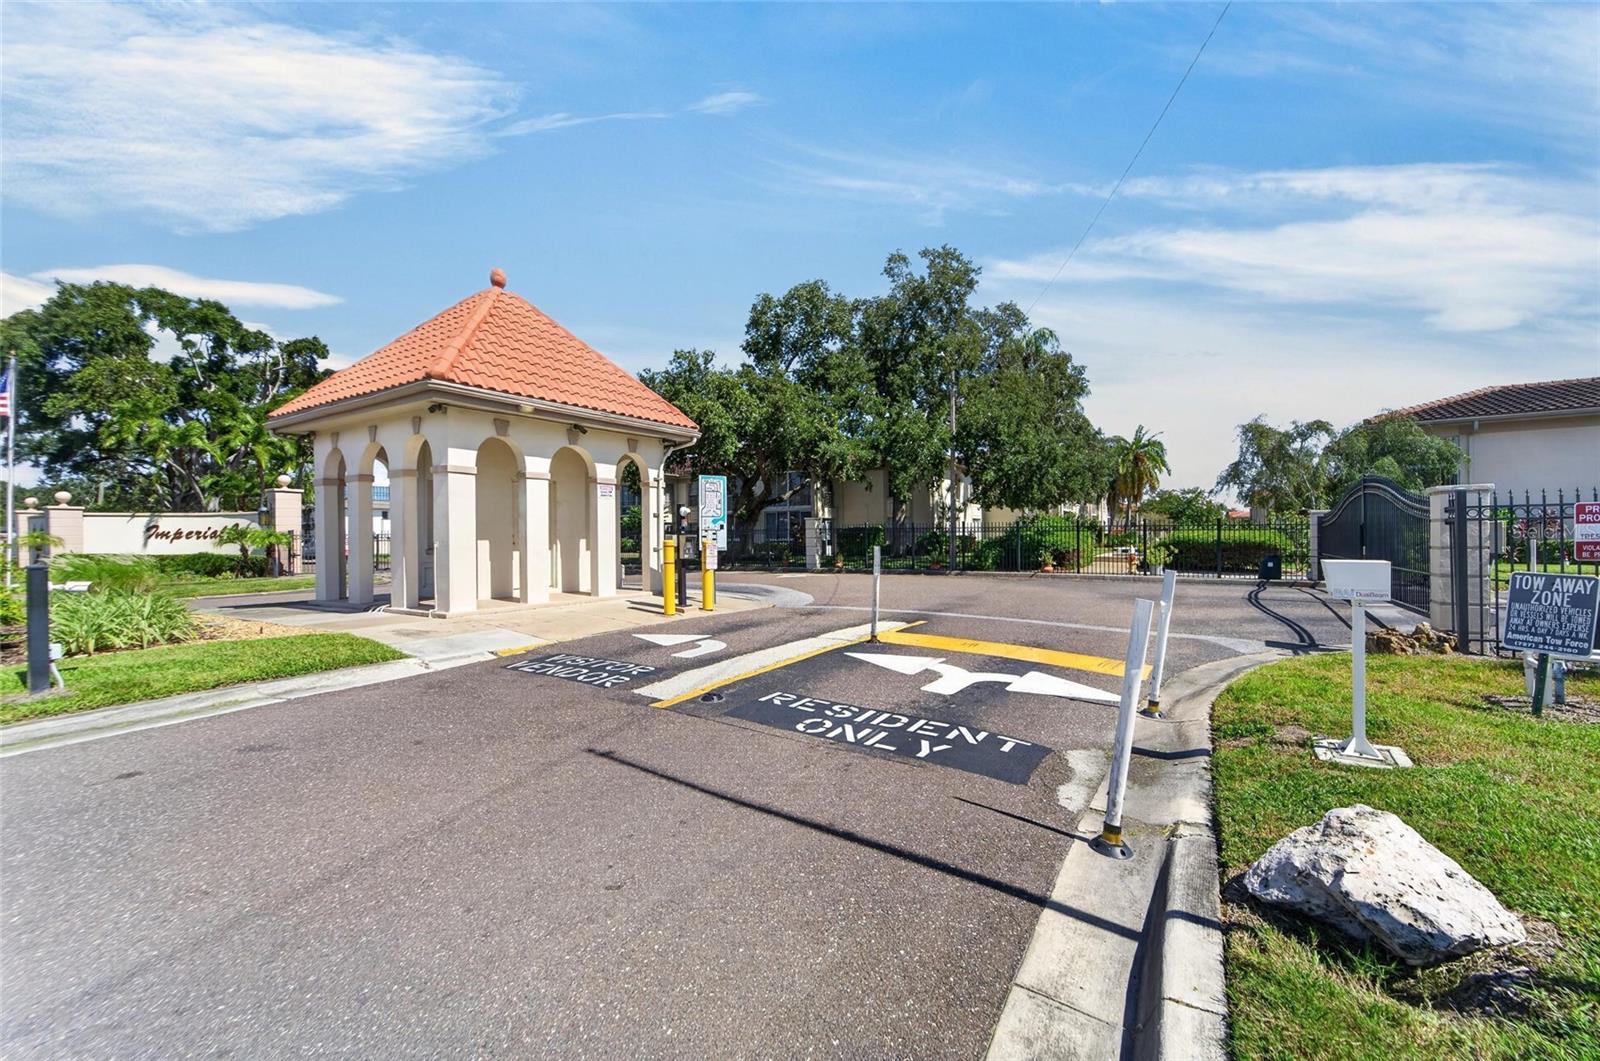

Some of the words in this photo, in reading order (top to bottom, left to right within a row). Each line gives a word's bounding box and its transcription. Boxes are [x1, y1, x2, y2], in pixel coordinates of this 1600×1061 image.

[1515, 575, 1545, 591] TOW
[1552, 578, 1595, 595] AWAY
[1531, 590, 1573, 608] ZONE
[1510, 602, 1558, 614] UNAUTHORIZED
[1561, 606, 1592, 618] VEHICLES
[1520, 610, 1544, 621] VESSELS
[1545, 613, 1558, 622] WILL
[1560, 614, 1568, 623] BE
[1571, 615, 1592, 625] TOWED
[1537, 627, 1548, 635] DAY
[1555, 629, 1570, 637] DAYS
[1562, 622, 1589, 633] EXPENSE
[1506, 631, 1543, 643] American
[1546, 635, 1563, 646] Tow
[1564, 638, 1589, 649] Force
[545, 653, 656, 675] VISITOR
[505, 660, 631, 688] VENDOR
[758, 691, 1033, 753] RESIDENT
[795, 718, 952, 758] ONLY
